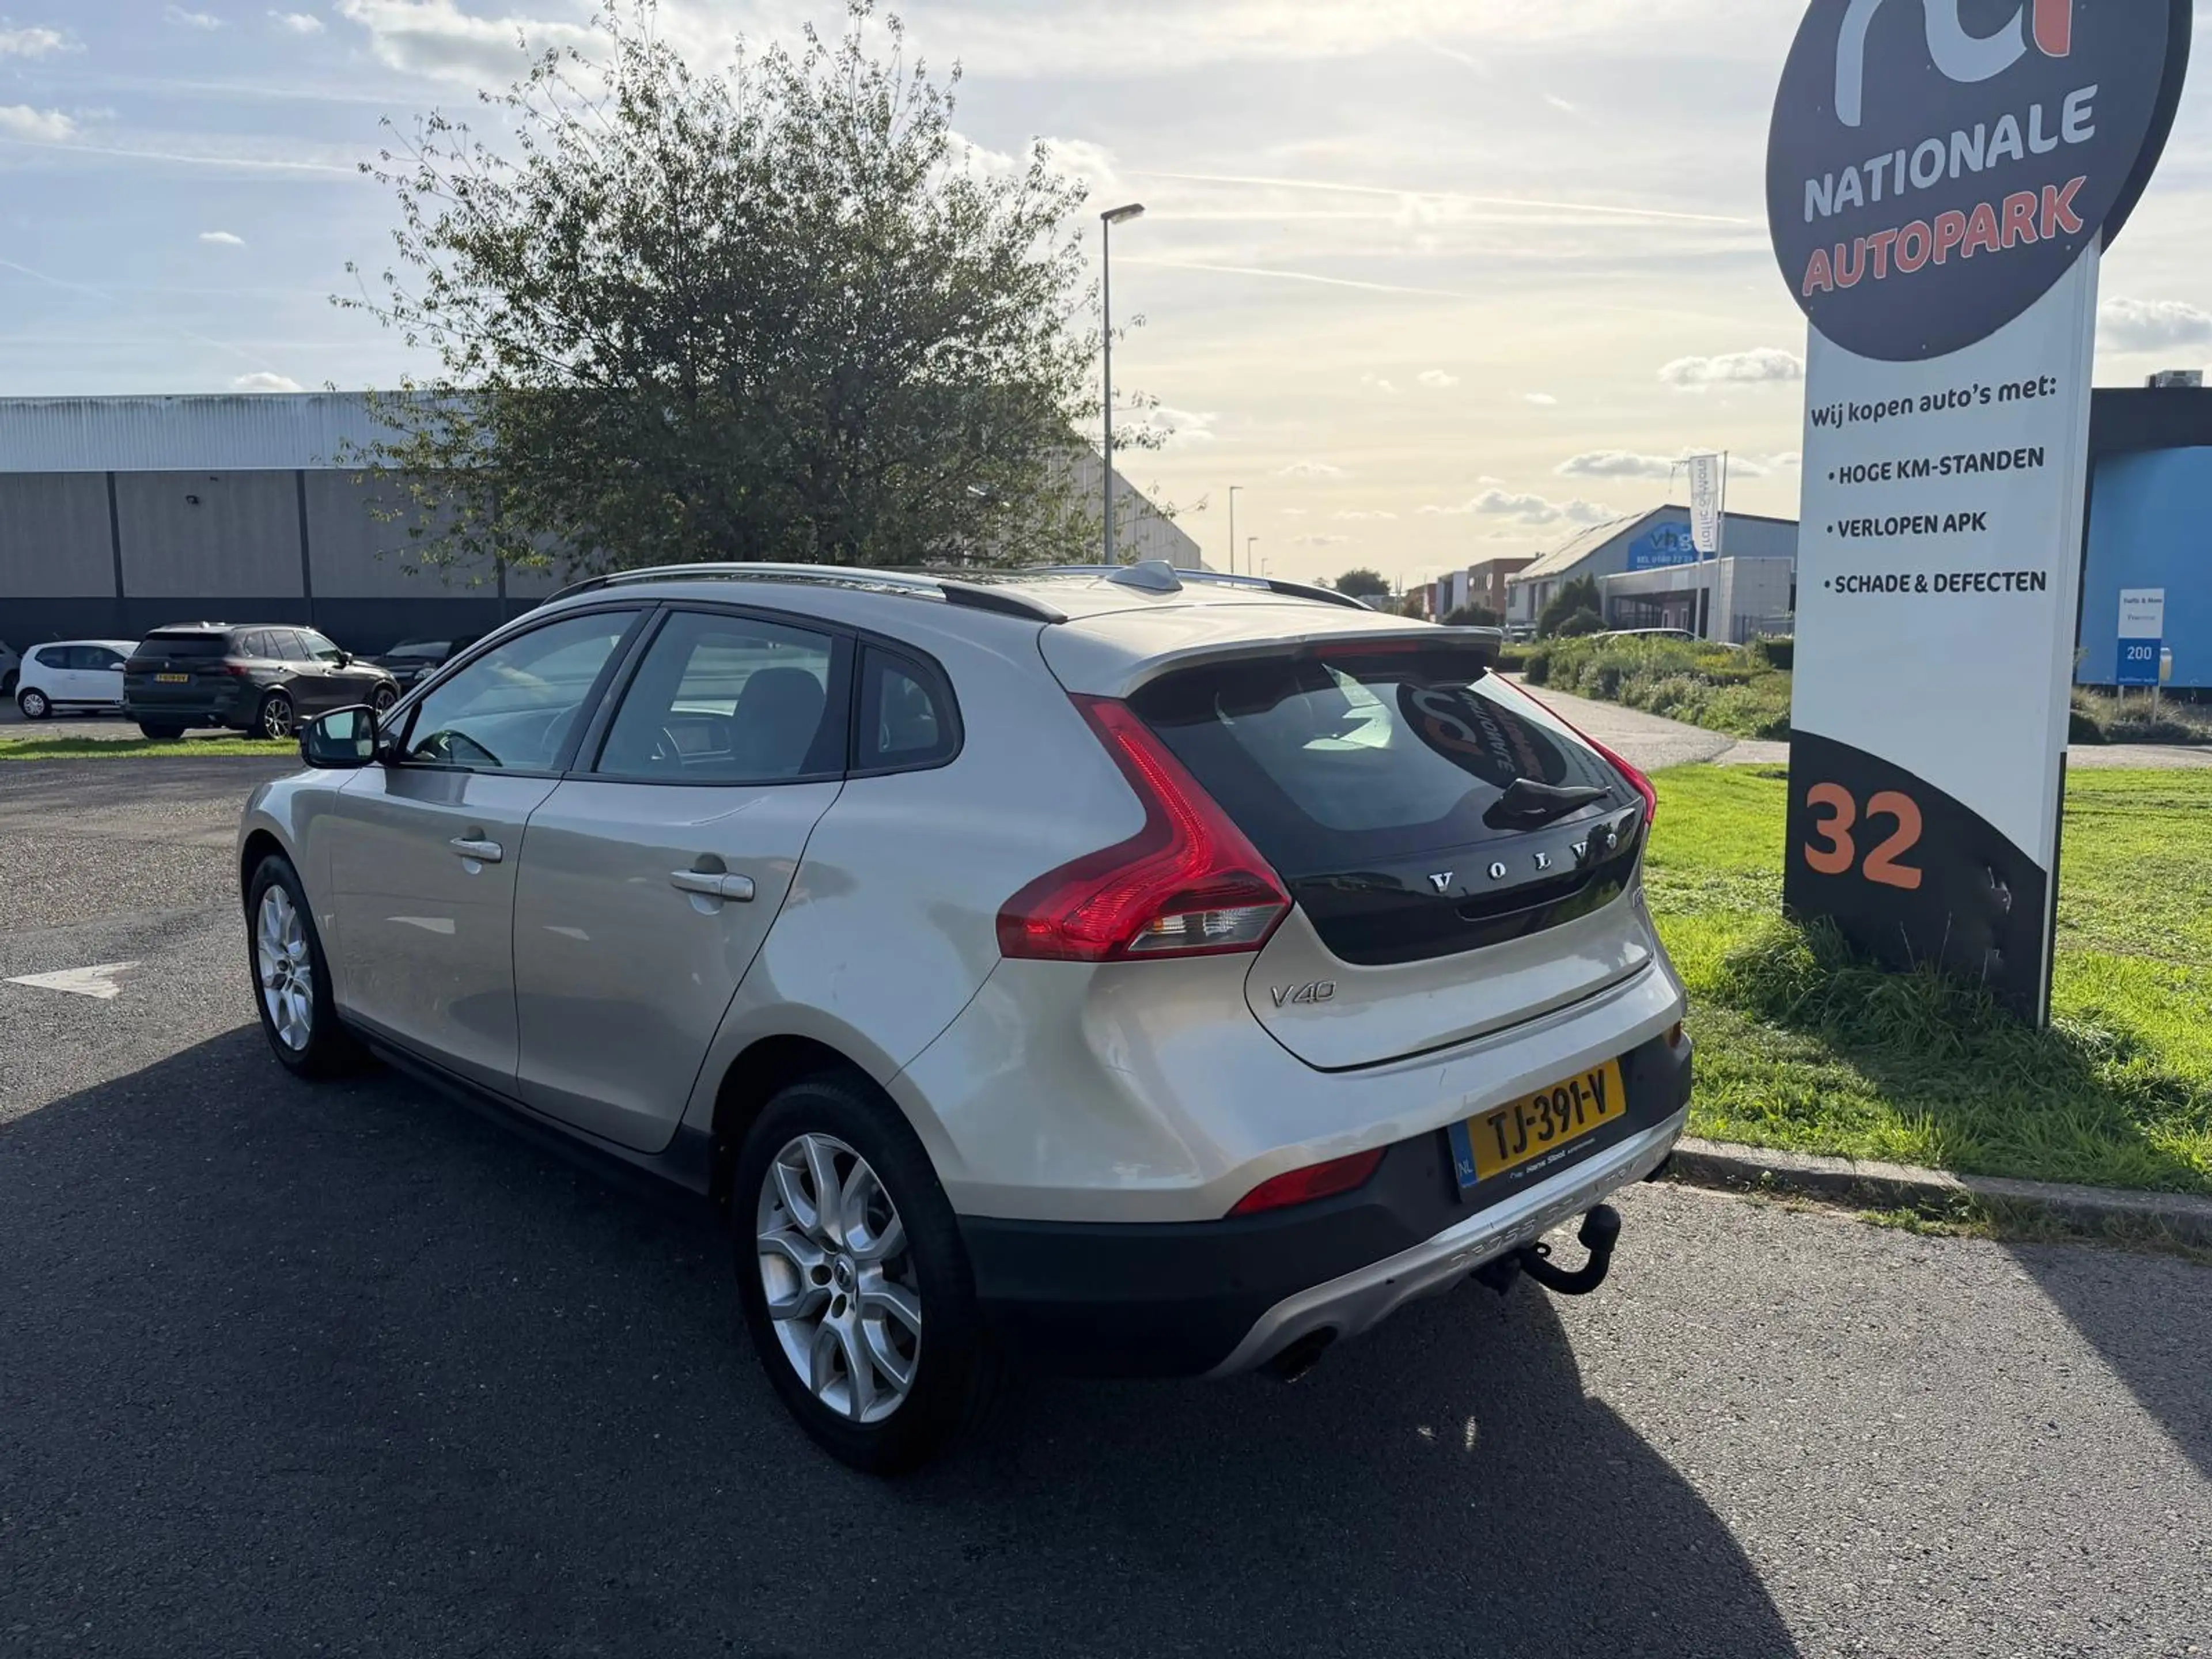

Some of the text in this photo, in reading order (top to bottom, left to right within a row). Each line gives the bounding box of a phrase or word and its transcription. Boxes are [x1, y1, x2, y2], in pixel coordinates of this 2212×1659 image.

[1804, 84, 2098, 222] NATIONALE
[1802, 175, 2086, 296] AUTOPARK
[1811, 374, 2057, 429] Wij kopen auto's met:
[1839, 447, 2044, 485] HOGE KM-STANDEN
[1837, 511, 1987, 539] VERLOPEN APK
[1835, 571, 2047, 594] SCHADE & DEFECTEN
[2127, 646, 2153, 660] 200
[1427, 833, 1618, 893] VOLVO
[1804, 782, 1922, 890] 32
[1271, 980, 1337, 1008] V40
[1457, 1157, 1474, 1177] NL
[1487, 1068, 1607, 1161] TJ-391-V
